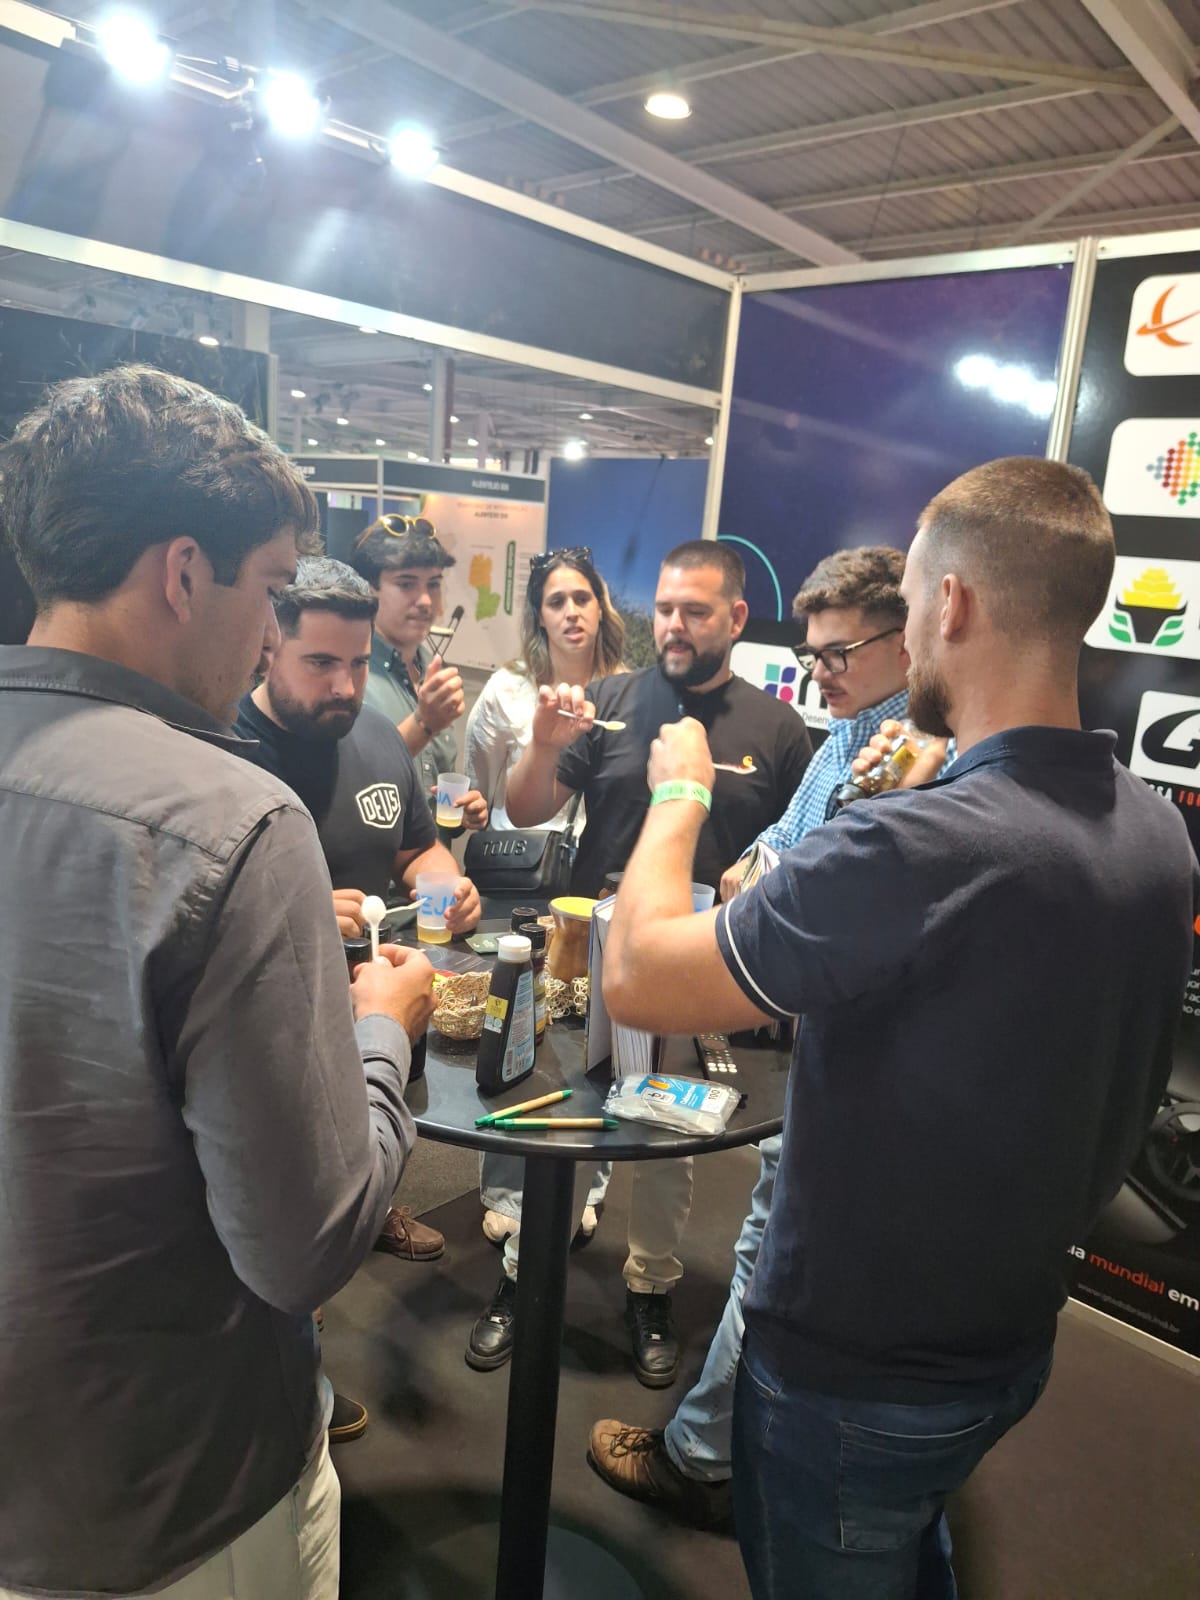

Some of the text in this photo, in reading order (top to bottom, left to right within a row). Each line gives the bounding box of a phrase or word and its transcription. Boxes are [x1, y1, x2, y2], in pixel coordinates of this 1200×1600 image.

[362, 789, 398, 822] DEUS
[483, 840, 528, 856] TOUS
[1089, 1253, 1165, 1295] mundial
[1168, 1289, 1200, 1311] em
